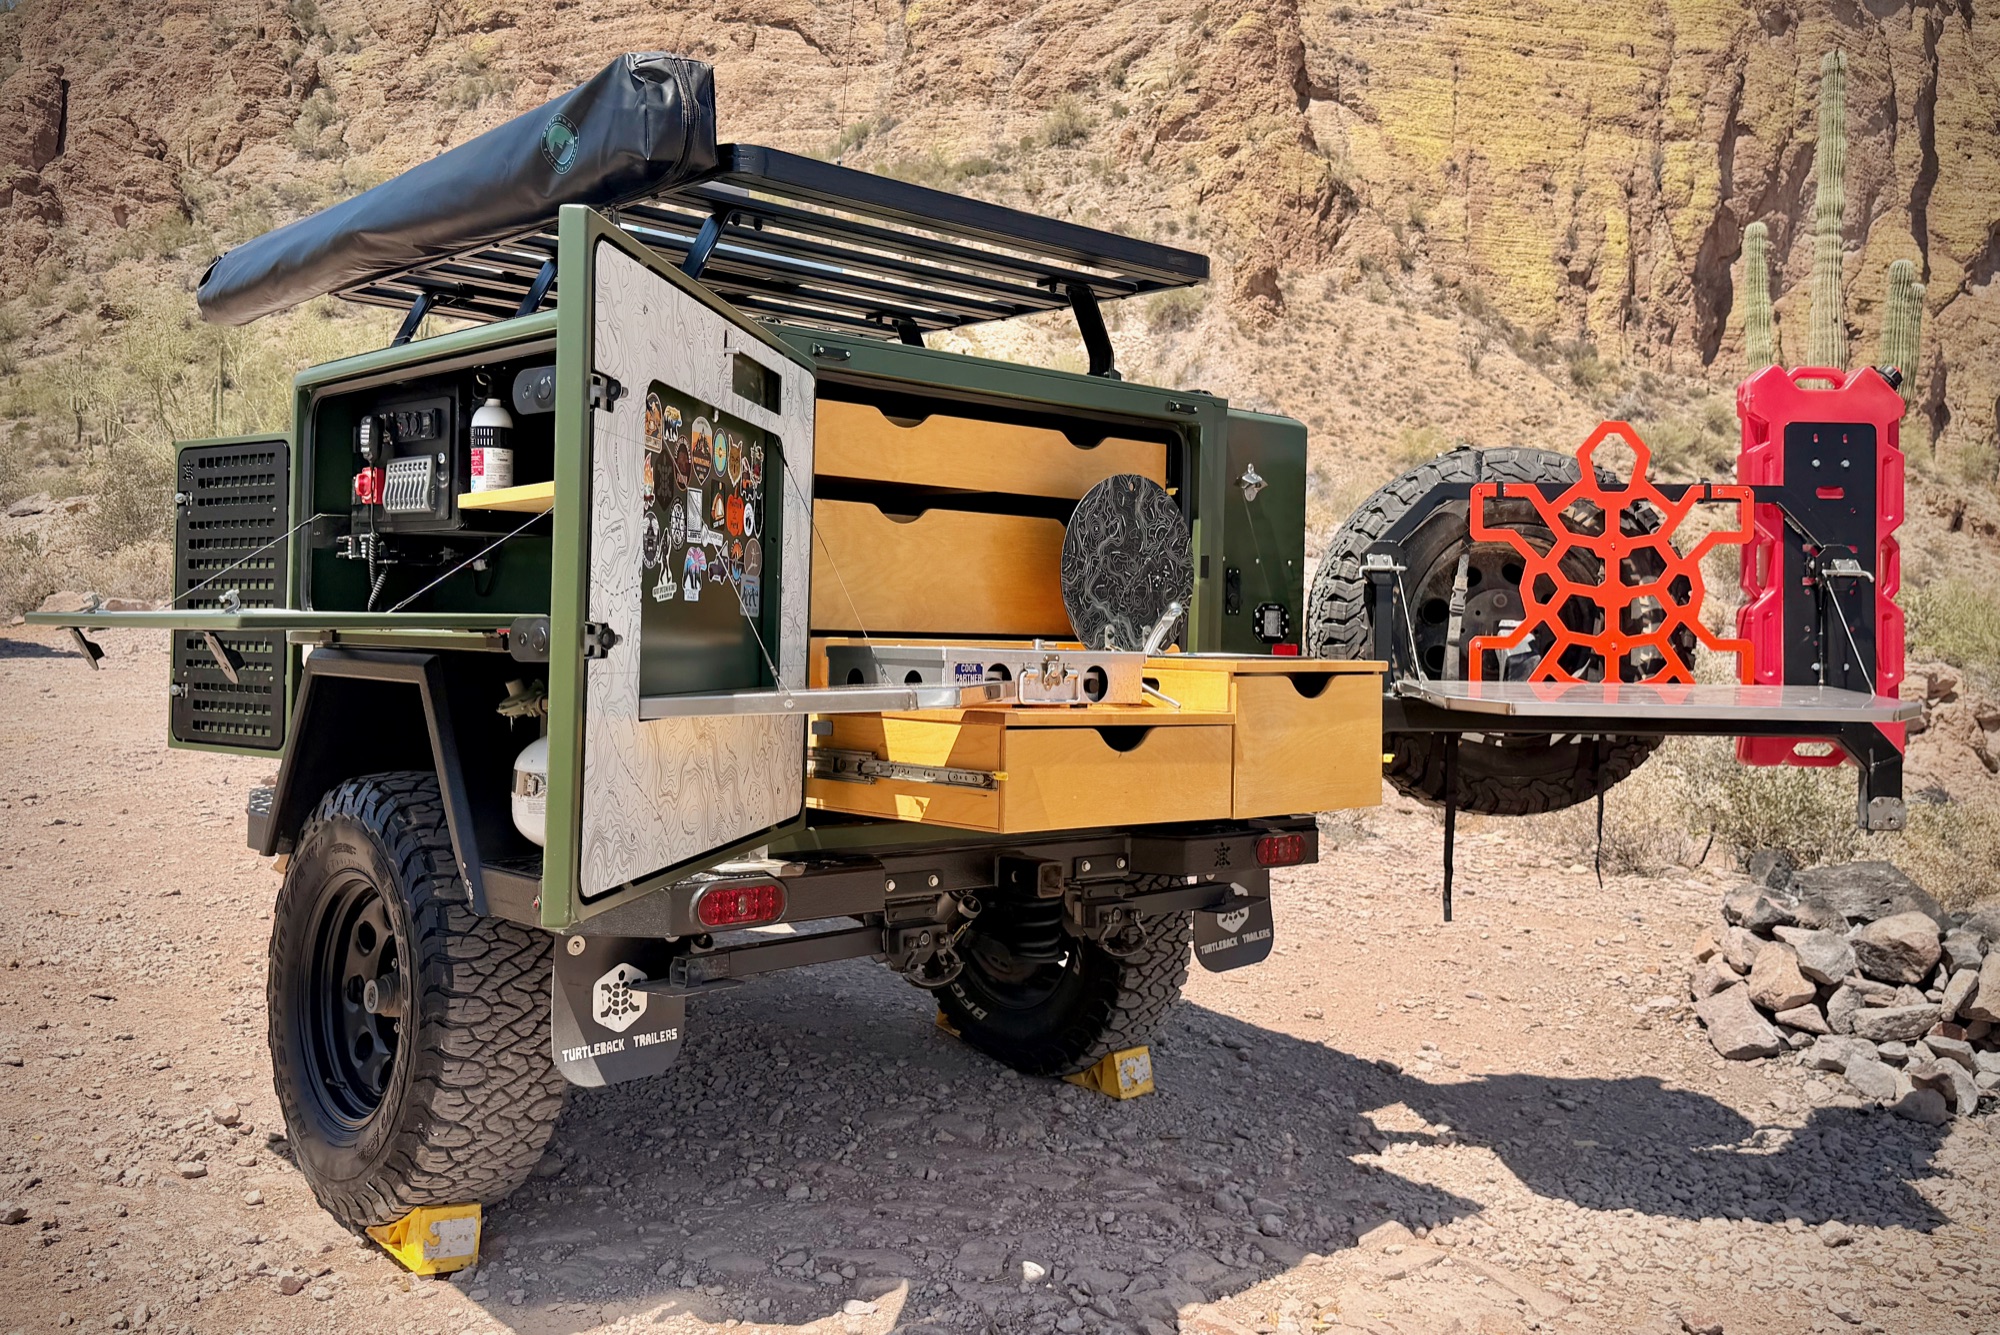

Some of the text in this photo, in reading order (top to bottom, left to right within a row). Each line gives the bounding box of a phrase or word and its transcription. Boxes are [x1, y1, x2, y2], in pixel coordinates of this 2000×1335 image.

[960, 664, 977, 673] COOK
[955, 673, 982, 686] PARTNER
[1199, 928, 1271, 955] TURTLEBACK TRAILERS
[561, 1028, 678, 1062] TURTLEBACK TRAILERS
